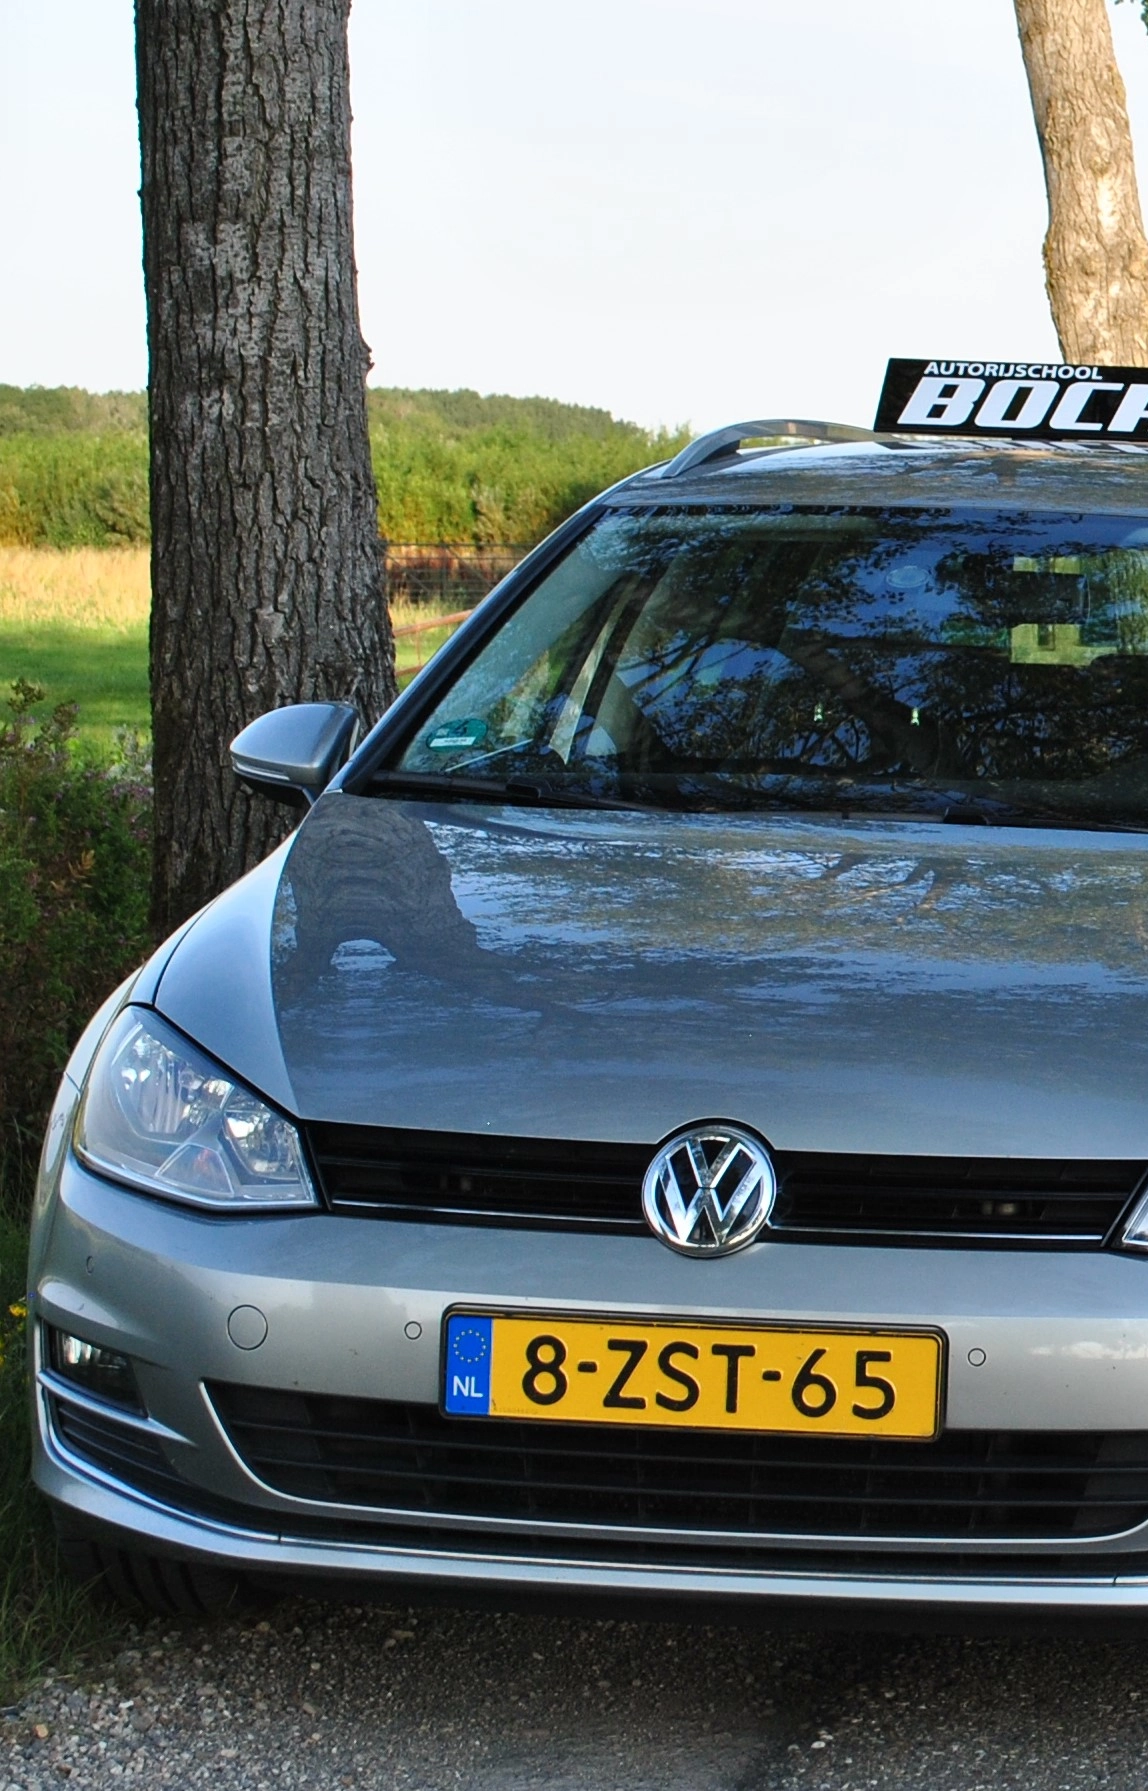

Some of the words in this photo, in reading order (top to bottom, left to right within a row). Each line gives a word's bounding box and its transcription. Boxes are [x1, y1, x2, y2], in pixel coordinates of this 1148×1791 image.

[924, 361, 1103, 380] AUTORIJSCHOOL
[452, 1376, 483, 1398] NL
[522, 1334, 896, 1420] 8-ZST-65
